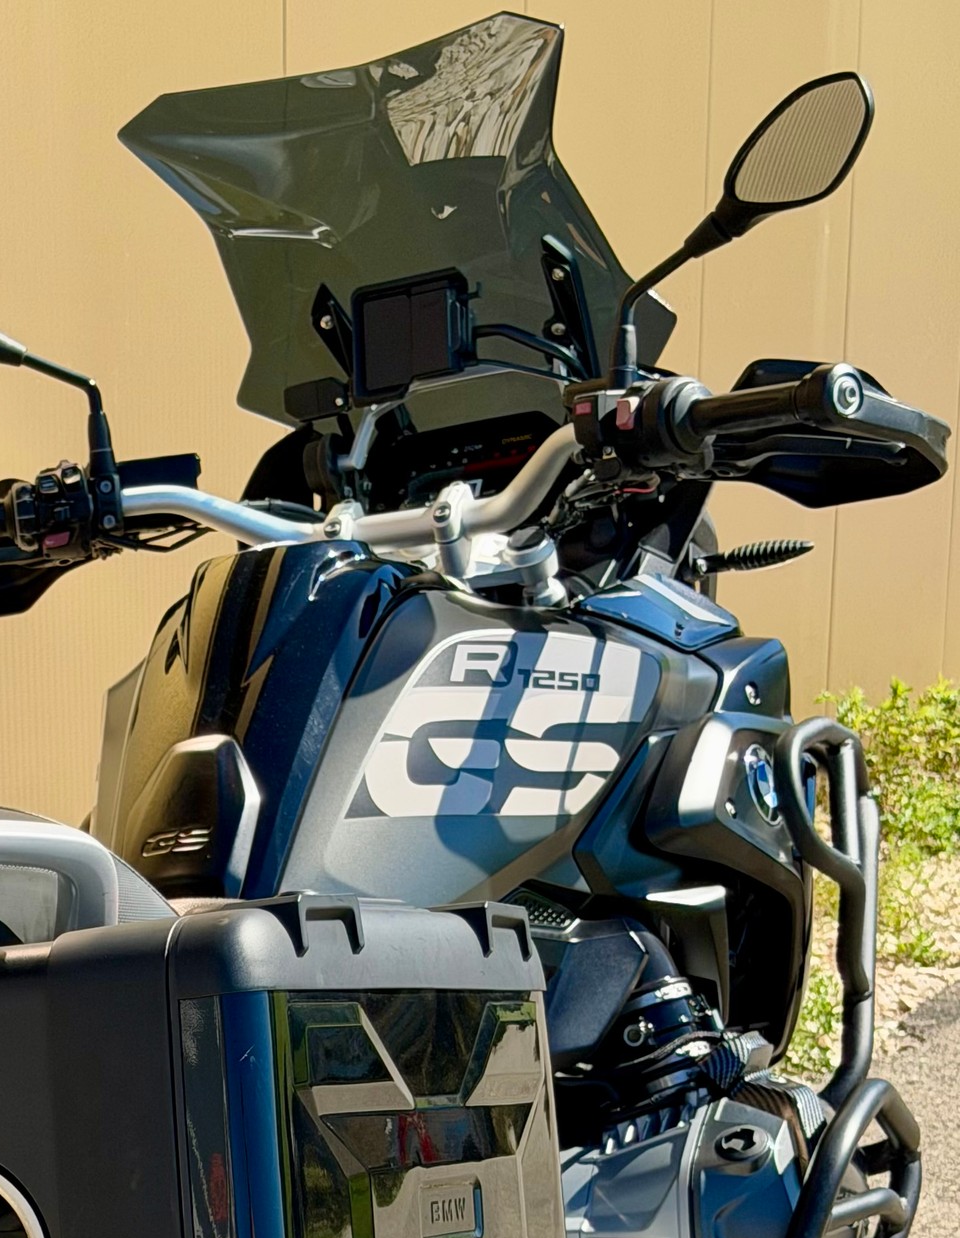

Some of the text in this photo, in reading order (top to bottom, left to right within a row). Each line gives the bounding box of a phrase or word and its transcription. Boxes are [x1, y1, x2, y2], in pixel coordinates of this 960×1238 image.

[450, 644, 600, 692] R 1250
[365, 690, 641, 816] GS
[430, 1197, 466, 1224] BMW
